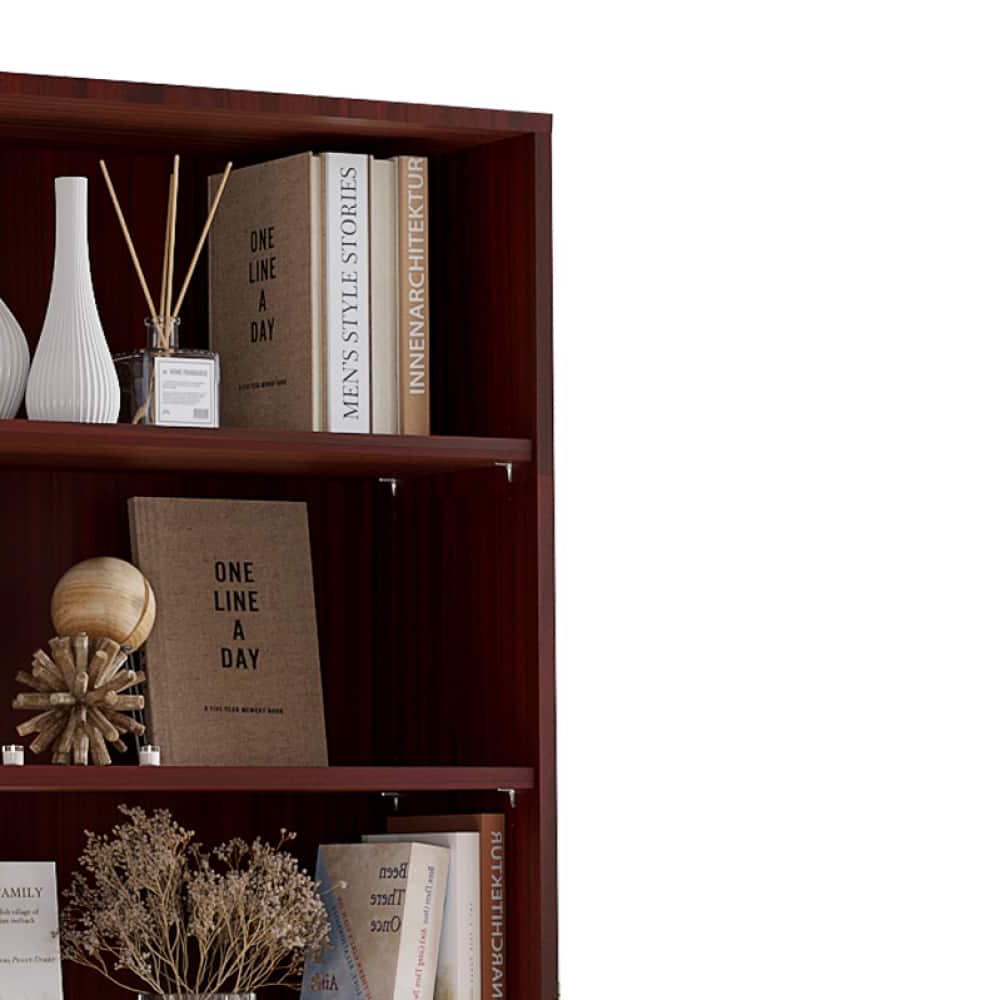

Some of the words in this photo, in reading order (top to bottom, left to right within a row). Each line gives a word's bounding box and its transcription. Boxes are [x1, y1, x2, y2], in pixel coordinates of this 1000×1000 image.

[340, 166, 358, 265] STORIES
[250, 227, 275, 252] ONE
[248, 257, 277, 284] LINE
[408, 157, 426, 395] INNENARCHITEKTUR
[258, 289, 266, 313] A
[341, 270, 359, 344] STYLE
[250, 318, 275, 343] DAY
[343, 349, 360, 420] MEN'S
[214, 561, 255, 583] ONE
[213, 590, 260, 612] LINE
[233, 619, 245, 641] A
[221, 648, 260, 670] DAY
